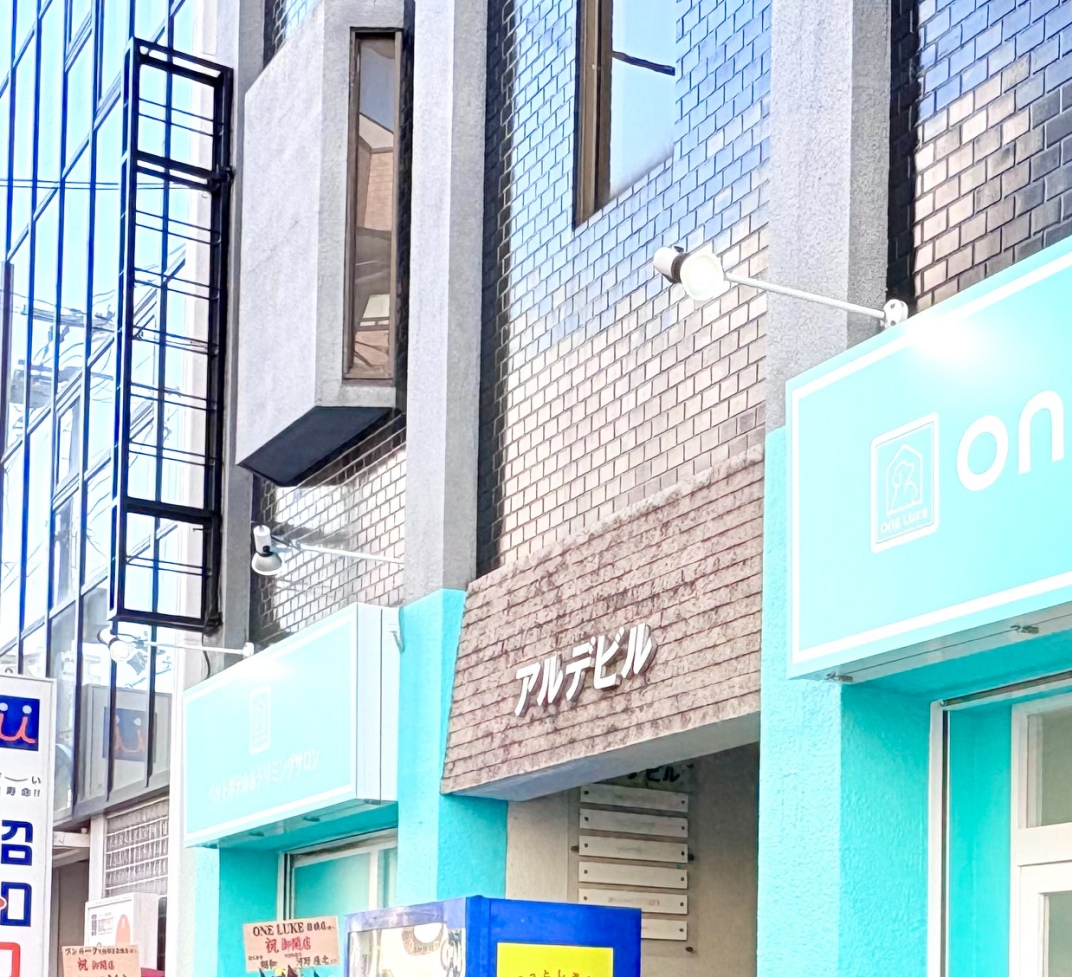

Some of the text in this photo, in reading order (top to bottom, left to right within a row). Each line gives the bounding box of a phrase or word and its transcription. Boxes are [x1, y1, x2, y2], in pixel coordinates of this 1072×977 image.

[514, 623, 654, 717] アルデビル
[253, 925, 274, 936] ONE
[277, 922, 304, 935] LUKE
